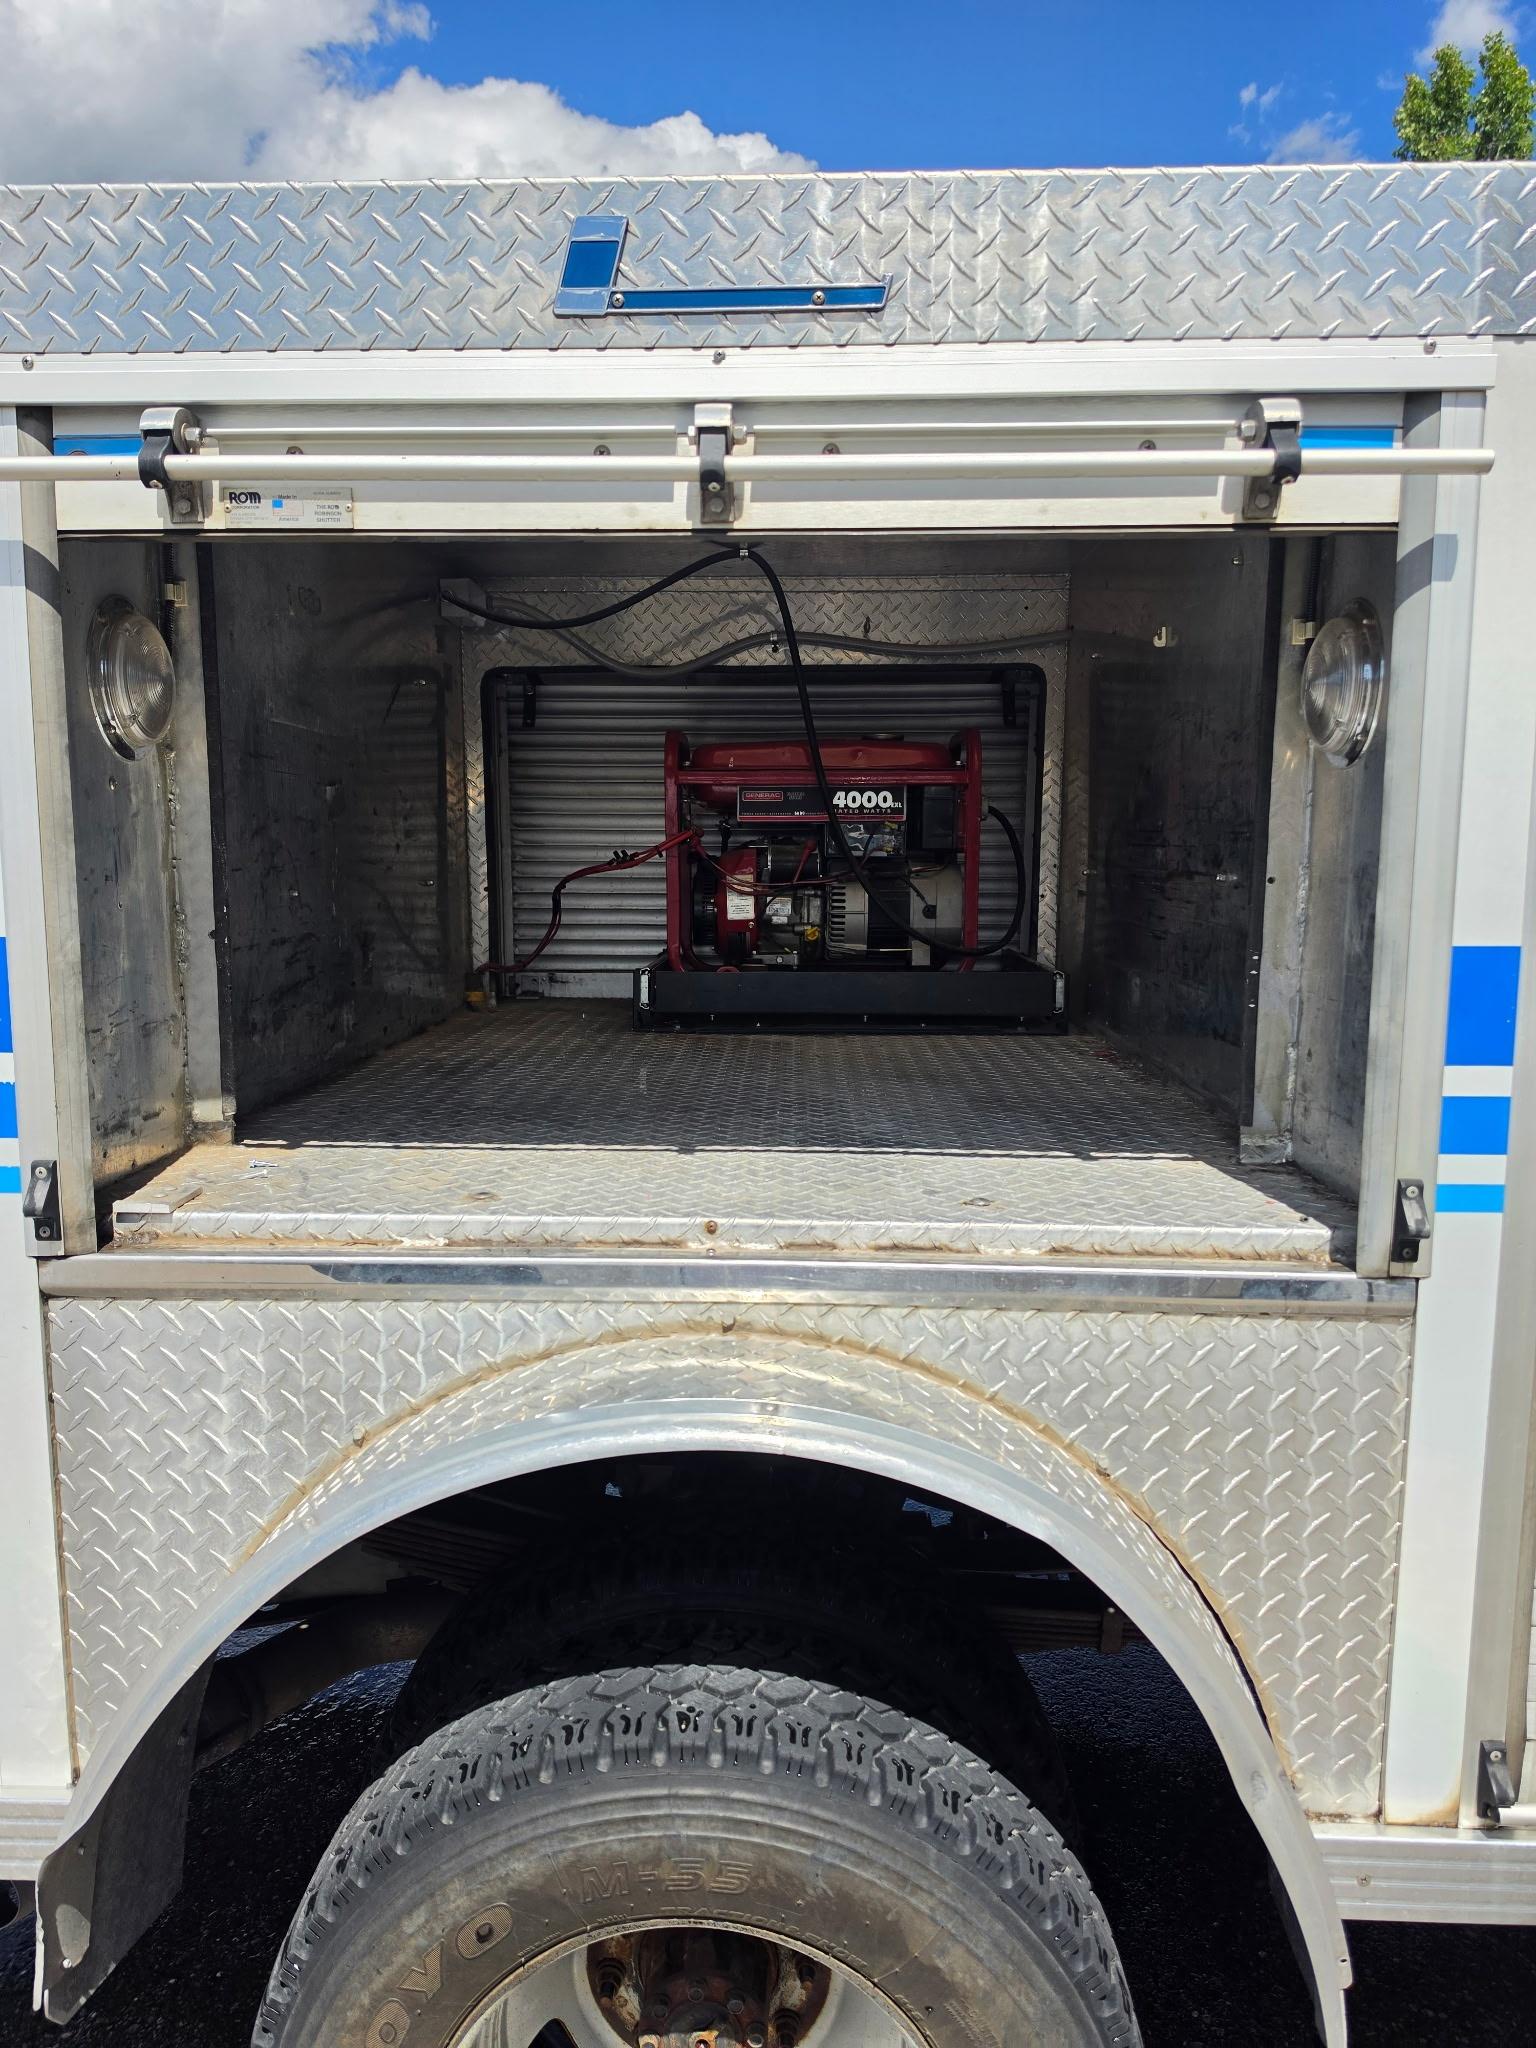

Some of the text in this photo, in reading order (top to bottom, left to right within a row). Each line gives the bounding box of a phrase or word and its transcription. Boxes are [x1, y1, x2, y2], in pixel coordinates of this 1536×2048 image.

[229, 491, 261, 504] ROM
[578, 1857, 753, 1904] M-55
[364, 1902, 513, 2048] OYO
